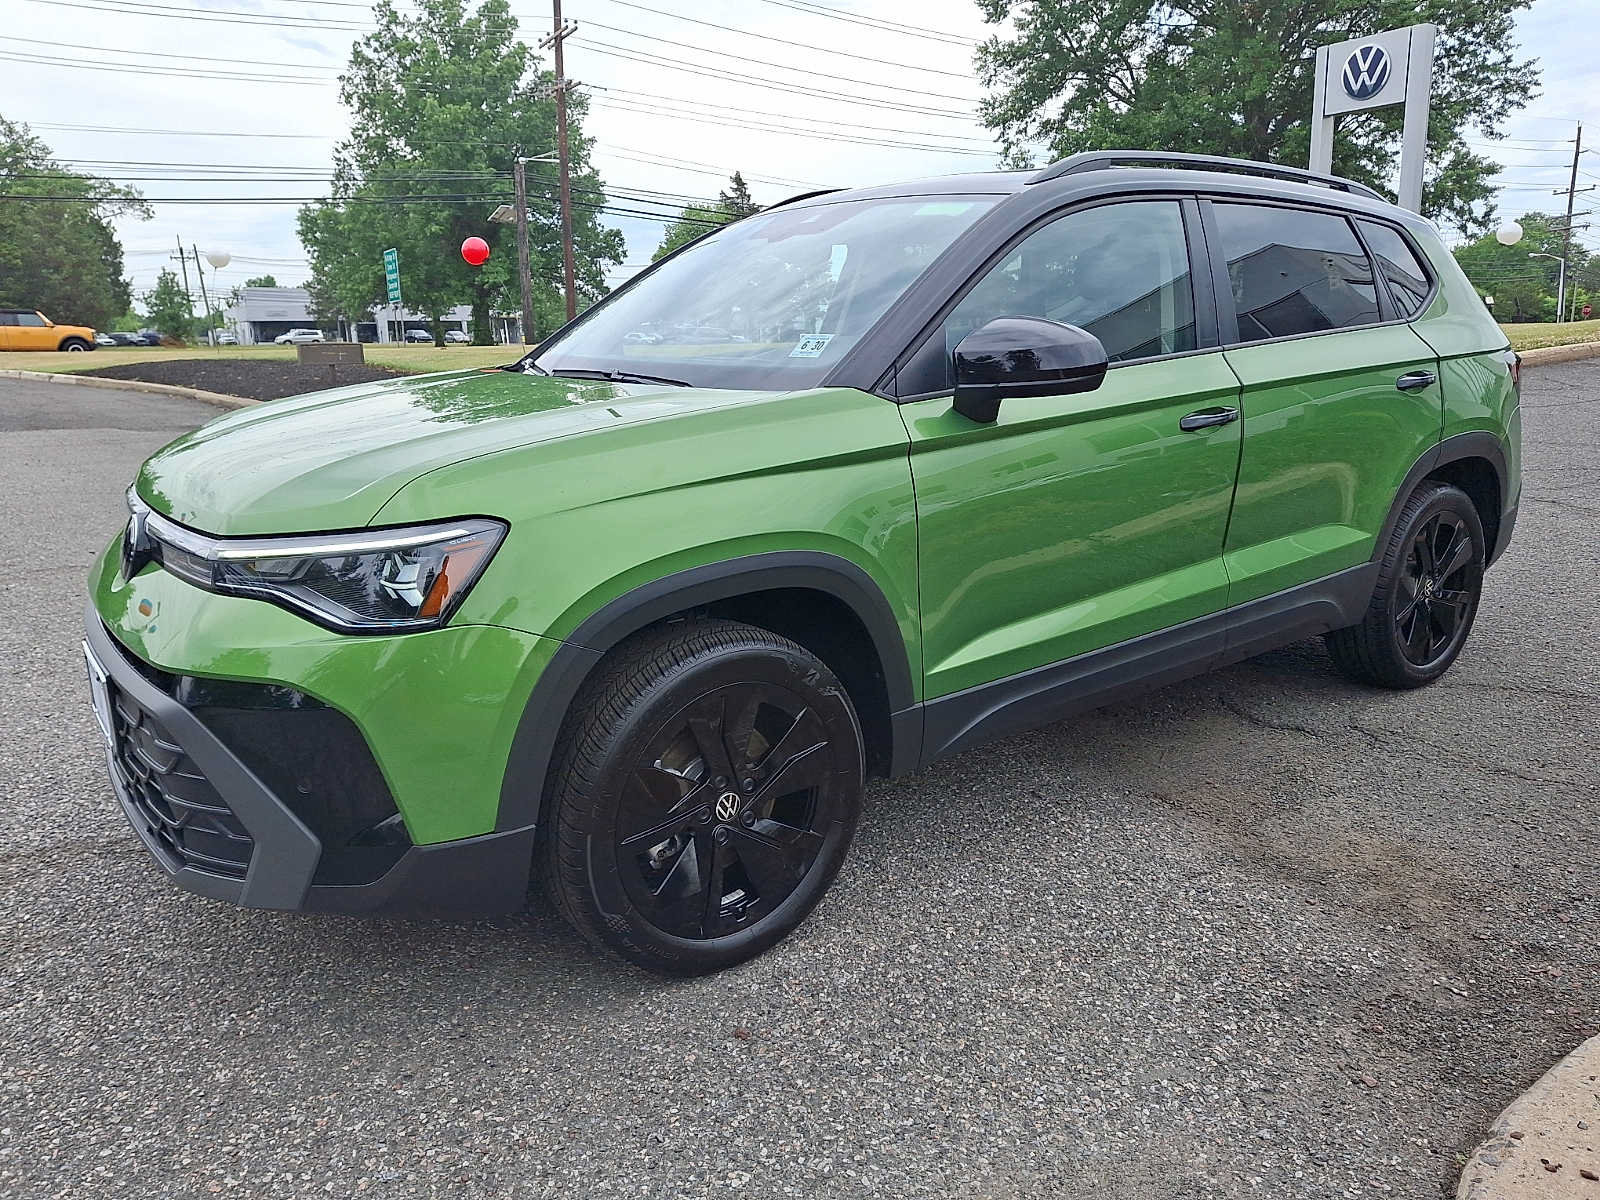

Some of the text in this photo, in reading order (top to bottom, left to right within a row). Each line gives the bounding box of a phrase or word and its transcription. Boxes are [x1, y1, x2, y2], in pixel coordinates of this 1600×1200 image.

[1342, 45, 1390, 99] VW
[801, 340, 825, 351] 6 30
[716, 793, 740, 820] VW
